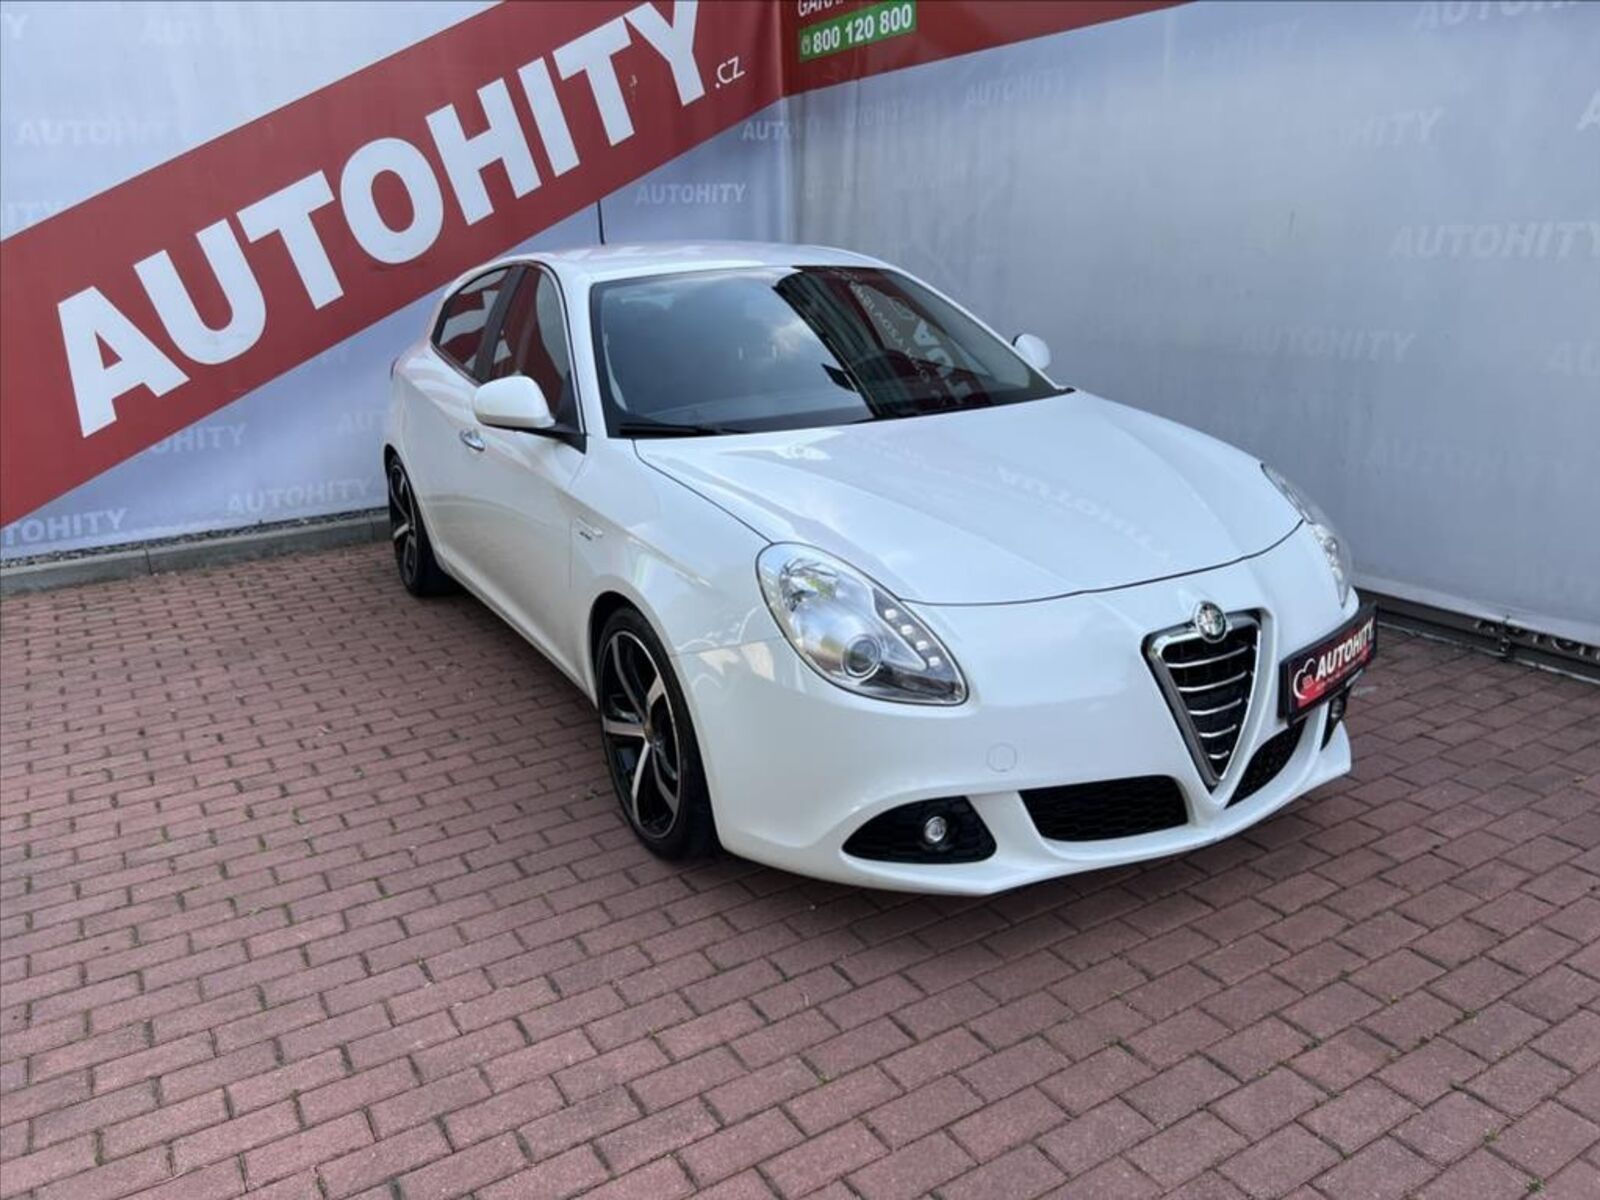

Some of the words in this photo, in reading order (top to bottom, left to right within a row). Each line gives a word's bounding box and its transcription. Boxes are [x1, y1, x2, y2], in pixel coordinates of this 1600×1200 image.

[813, 26, 840, 54] 800
[844, 15, 875, 45] 120
[879, 3, 912, 36] 800
[57, 0, 706, 438] AUTOHITY
[635, 182, 748, 206] AUTOHITY
[226, 477, 376, 514] AUTOHITY
[1316, 617, 1374, 682] AUTOHITY
